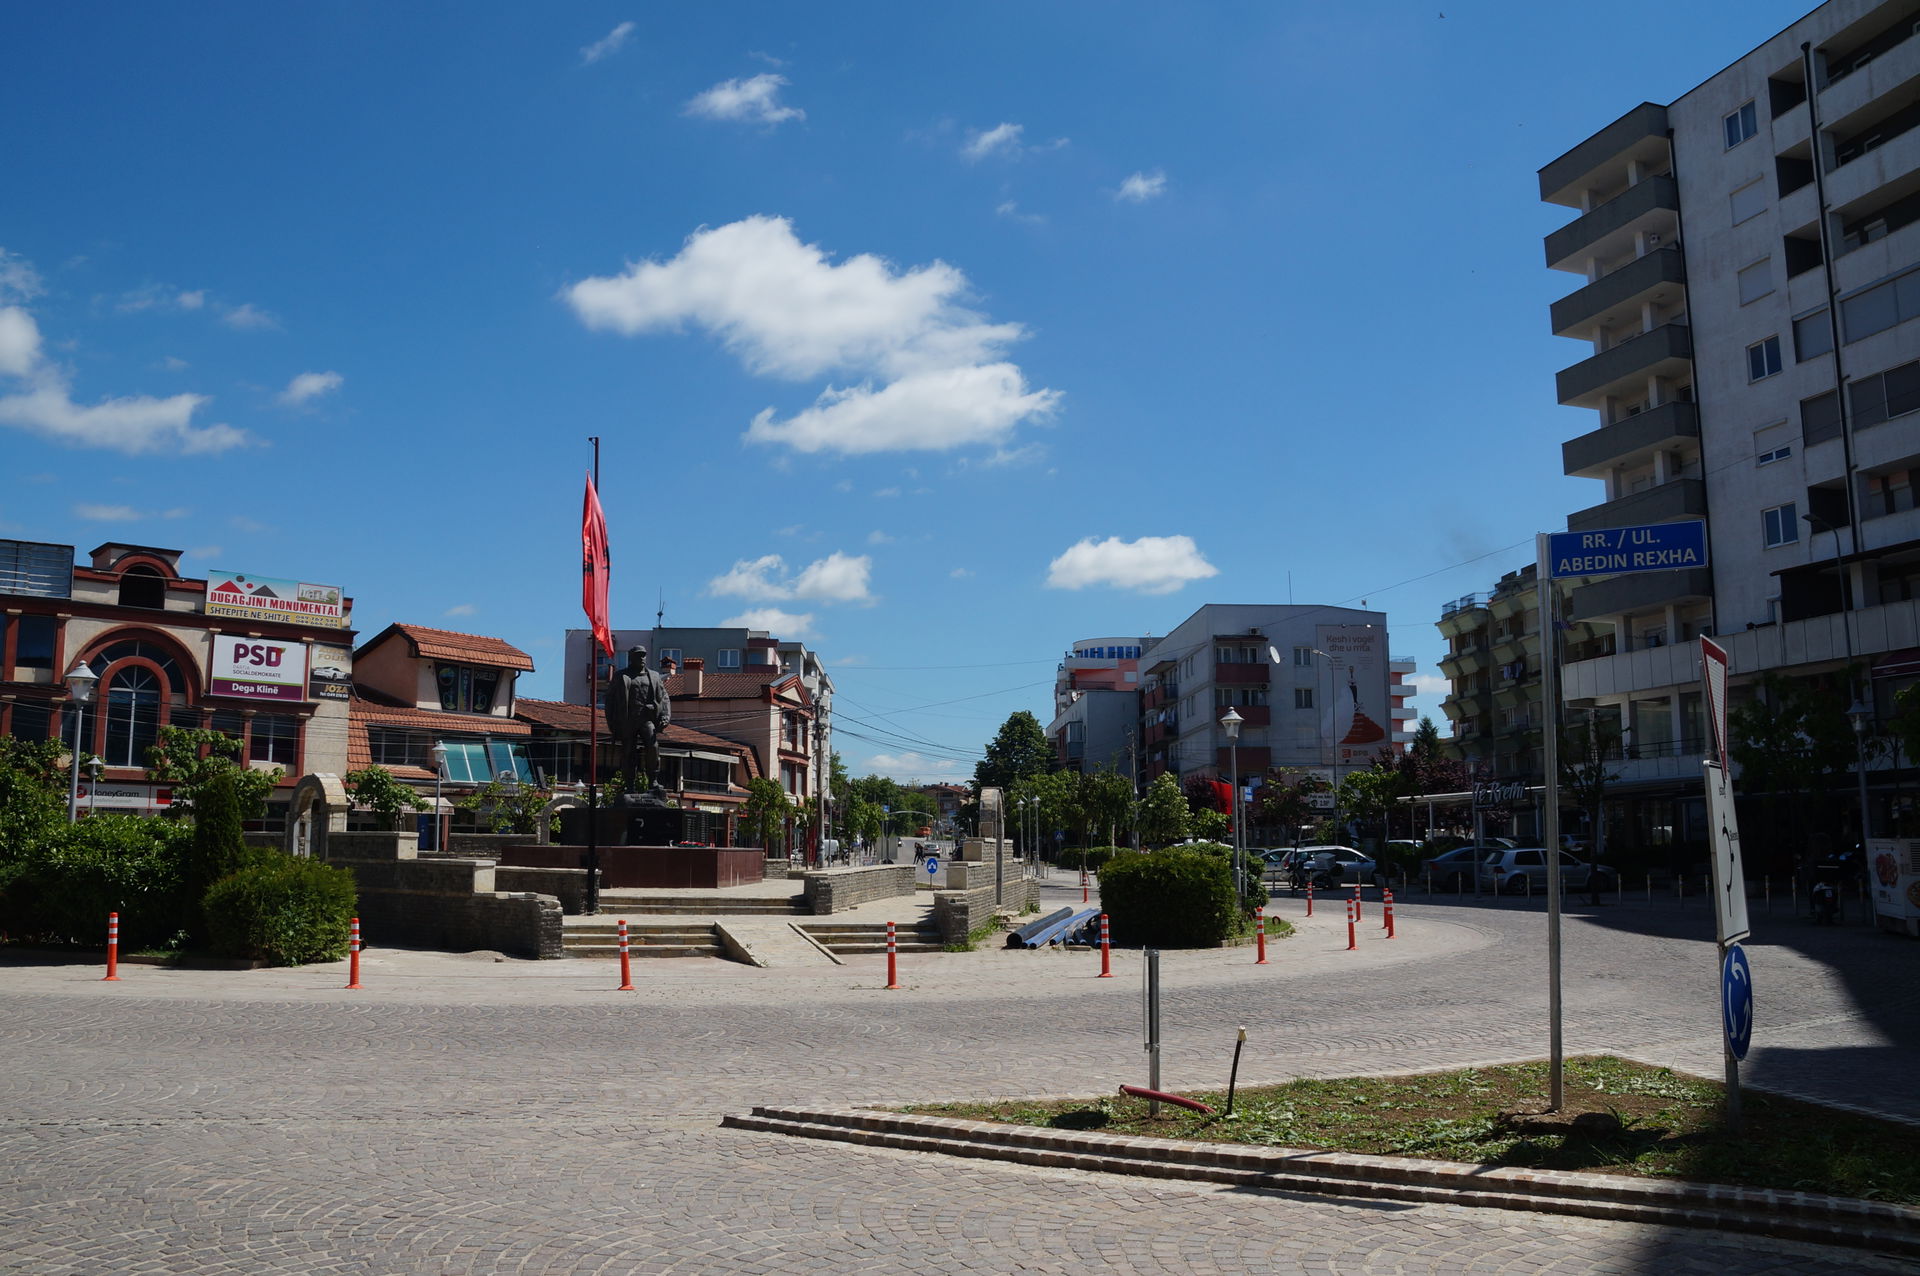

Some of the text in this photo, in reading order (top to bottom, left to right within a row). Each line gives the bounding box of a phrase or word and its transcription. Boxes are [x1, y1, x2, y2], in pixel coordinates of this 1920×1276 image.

[1582, 529, 1661, 549] RR. / UL.
[1558, 547, 1697, 573] ABEDIN REXHA
[210, 591, 340, 616] DUGAGJINI MONUMENTAL
[250, 611, 262, 619] NE
[263, 612, 290, 622] SHITJE
[233, 643, 286, 667] PSD
[231, 682, 279, 694] Dega Klinë
